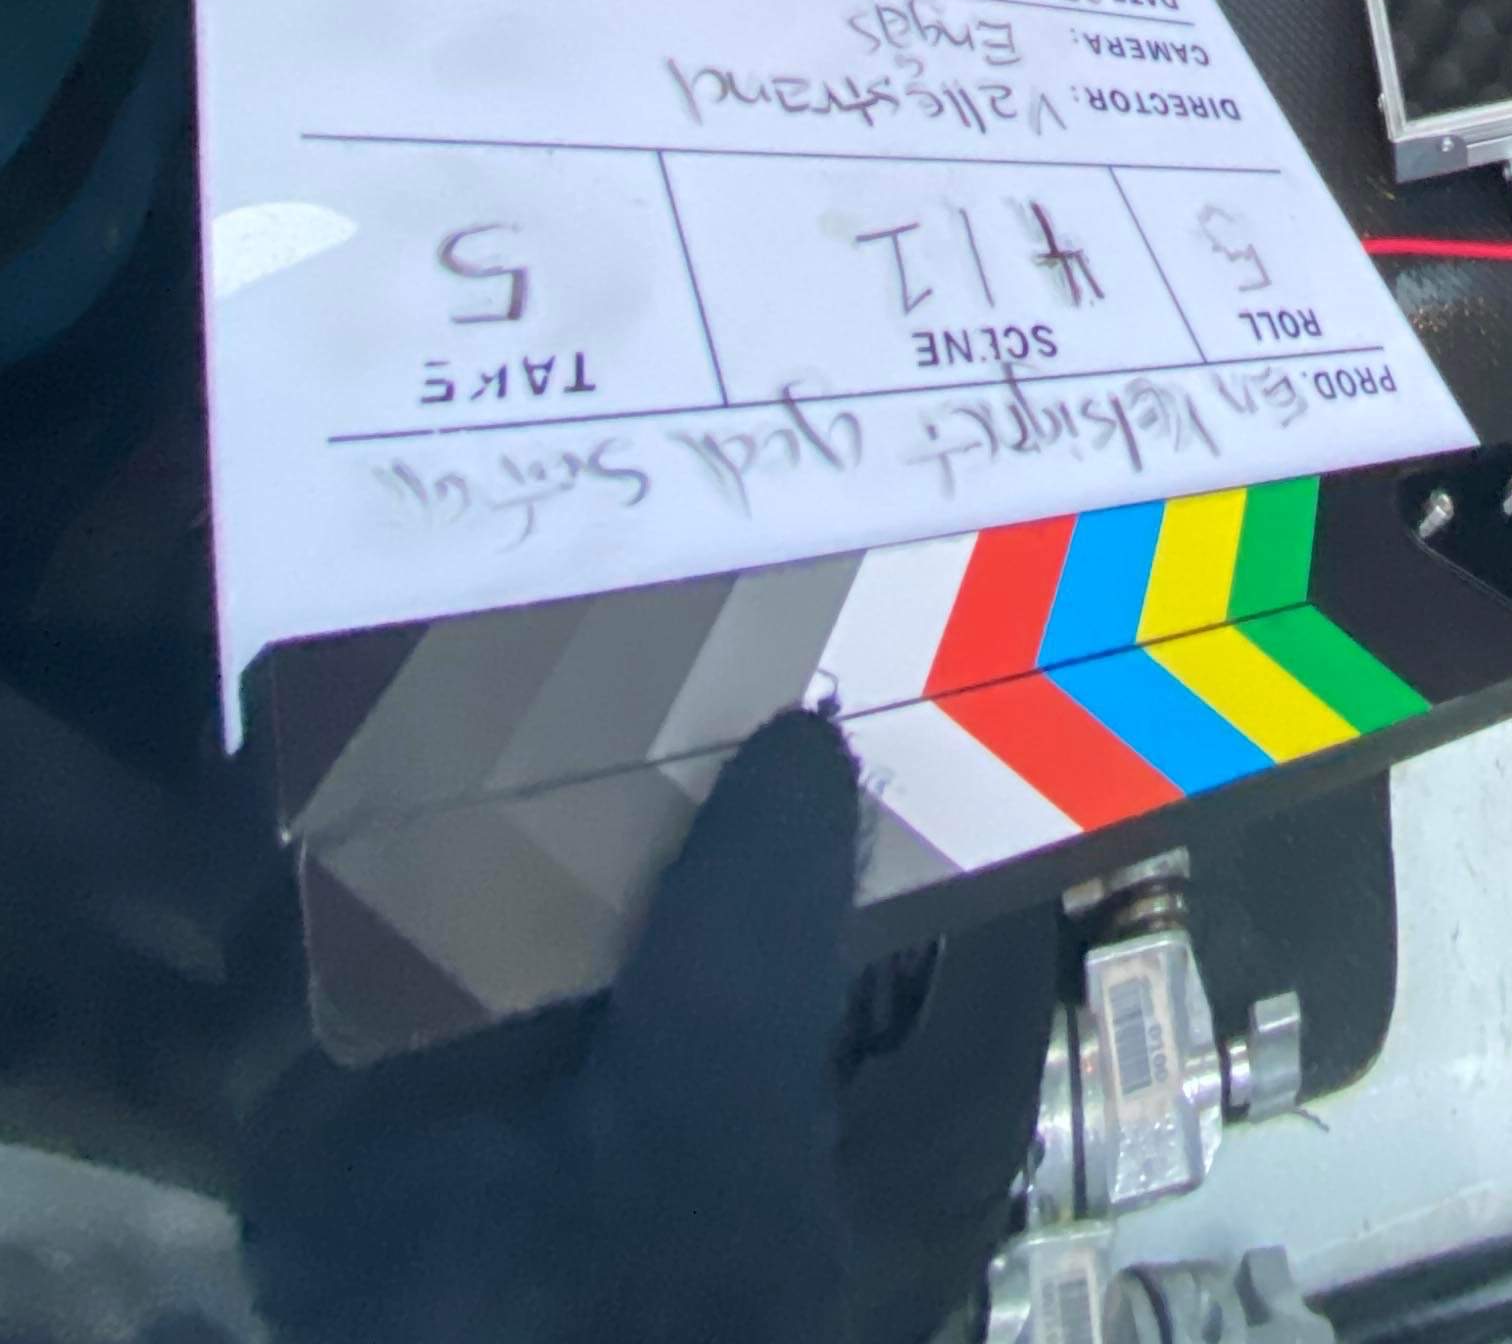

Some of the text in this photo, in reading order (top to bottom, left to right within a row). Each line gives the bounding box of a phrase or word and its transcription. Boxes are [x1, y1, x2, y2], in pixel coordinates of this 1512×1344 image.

[1071, 27, 1209, 67] CAMERA:
[1074, 85, 1241, 121] DIRECTOR:
[438, 223, 529, 324] 5
[1240, 310, 1322, 342] ROLL
[911, 325, 1058, 368] SCENE
[421, 351, 596, 403] TAKE
[1303, 364, 1396, 398] PROD.
